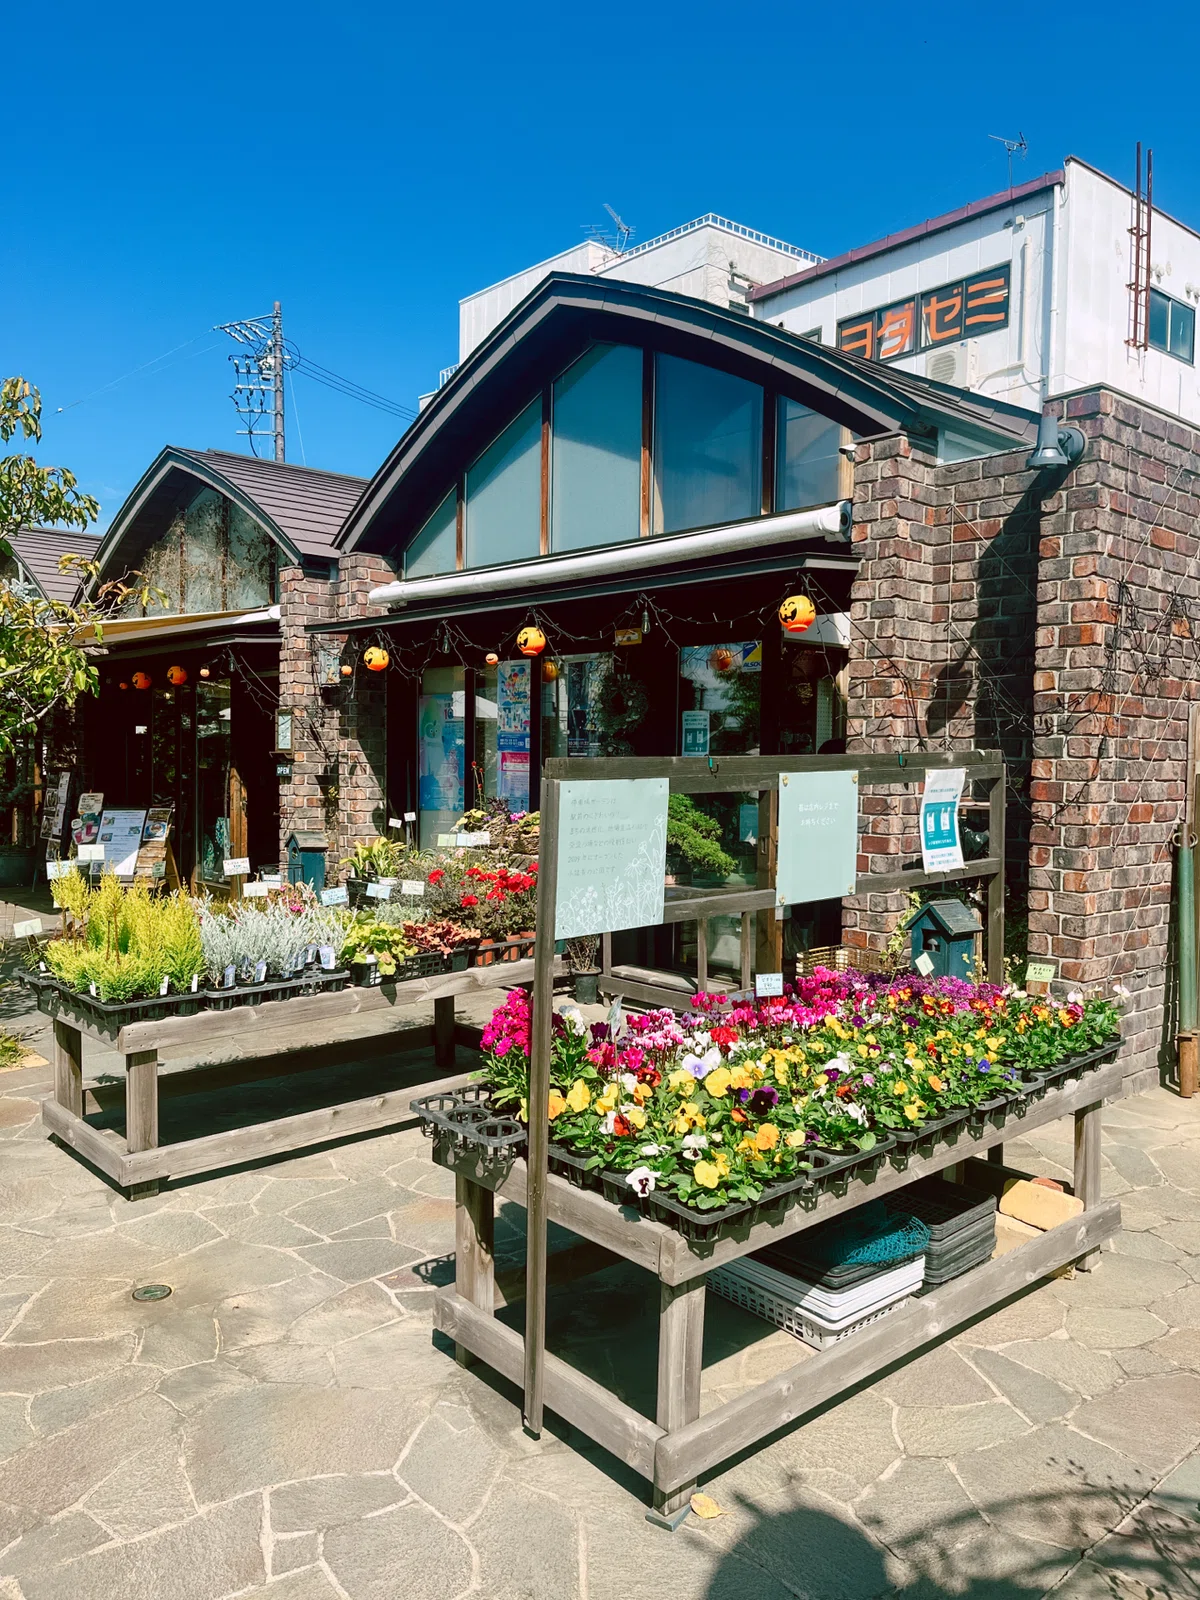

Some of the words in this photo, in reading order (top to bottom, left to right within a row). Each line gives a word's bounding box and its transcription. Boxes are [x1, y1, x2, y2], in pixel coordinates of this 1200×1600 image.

[277, 766, 290, 775] OPEN
[800, 817, 836, 828] お持ちください
